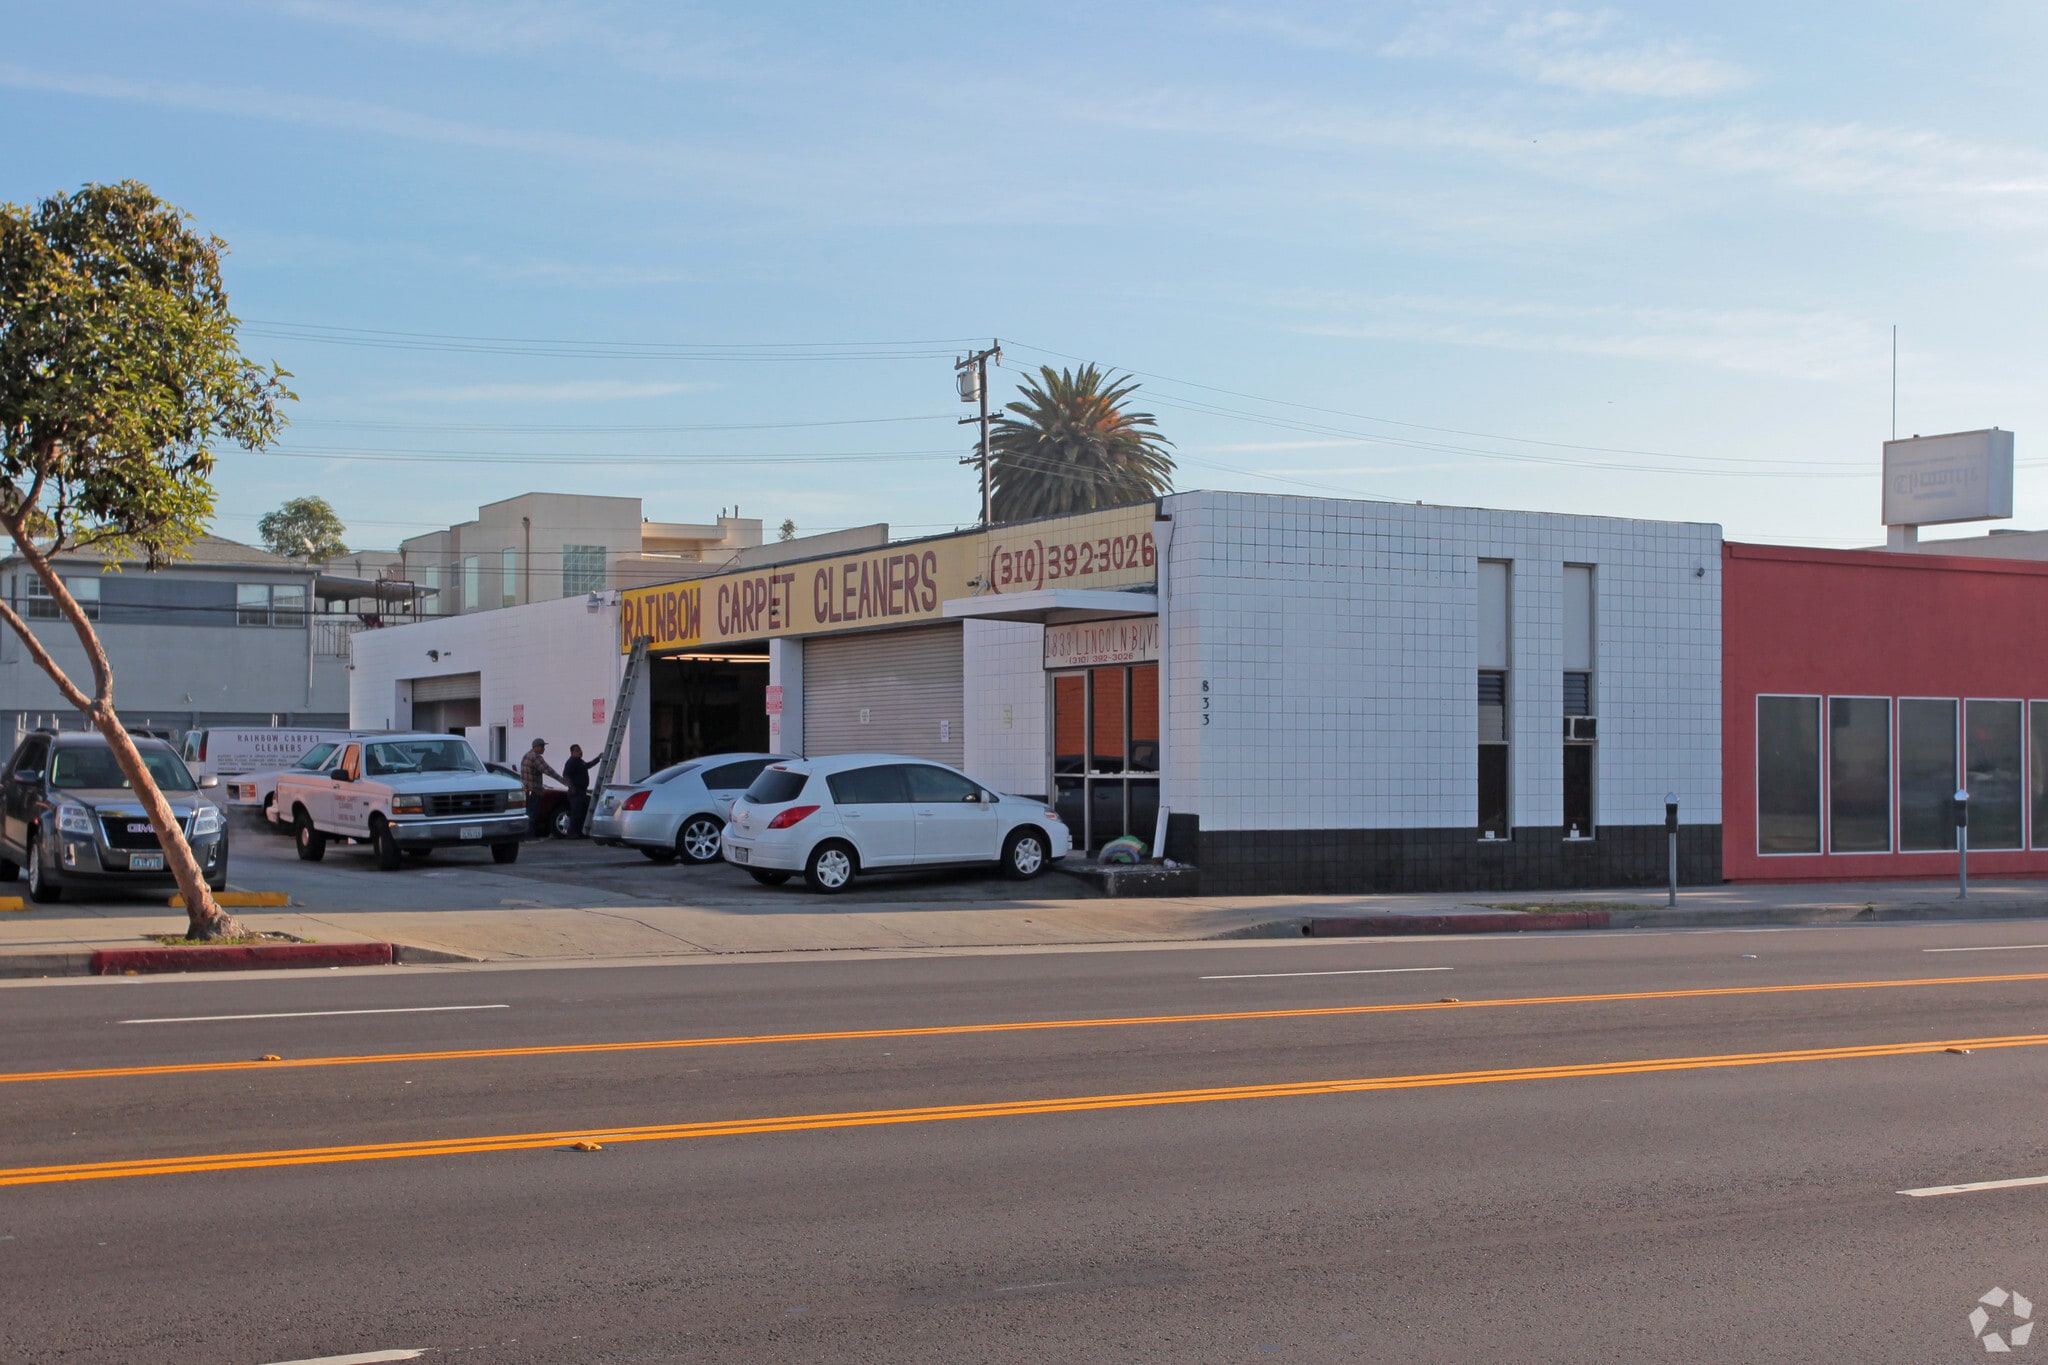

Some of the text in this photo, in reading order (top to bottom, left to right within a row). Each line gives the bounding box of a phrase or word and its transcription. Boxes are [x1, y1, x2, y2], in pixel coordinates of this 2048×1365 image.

[624, 551, 937, 646] RAINBOW CARPET CLEANERS
[1045, 632, 1071, 658] 1833
[1092, 653, 1134, 662] 392-3026
[237, 734, 320, 743] RAINBOW CARPET
[255, 744, 302, 752] CLEANERS
[127, 823, 155, 833] GM
